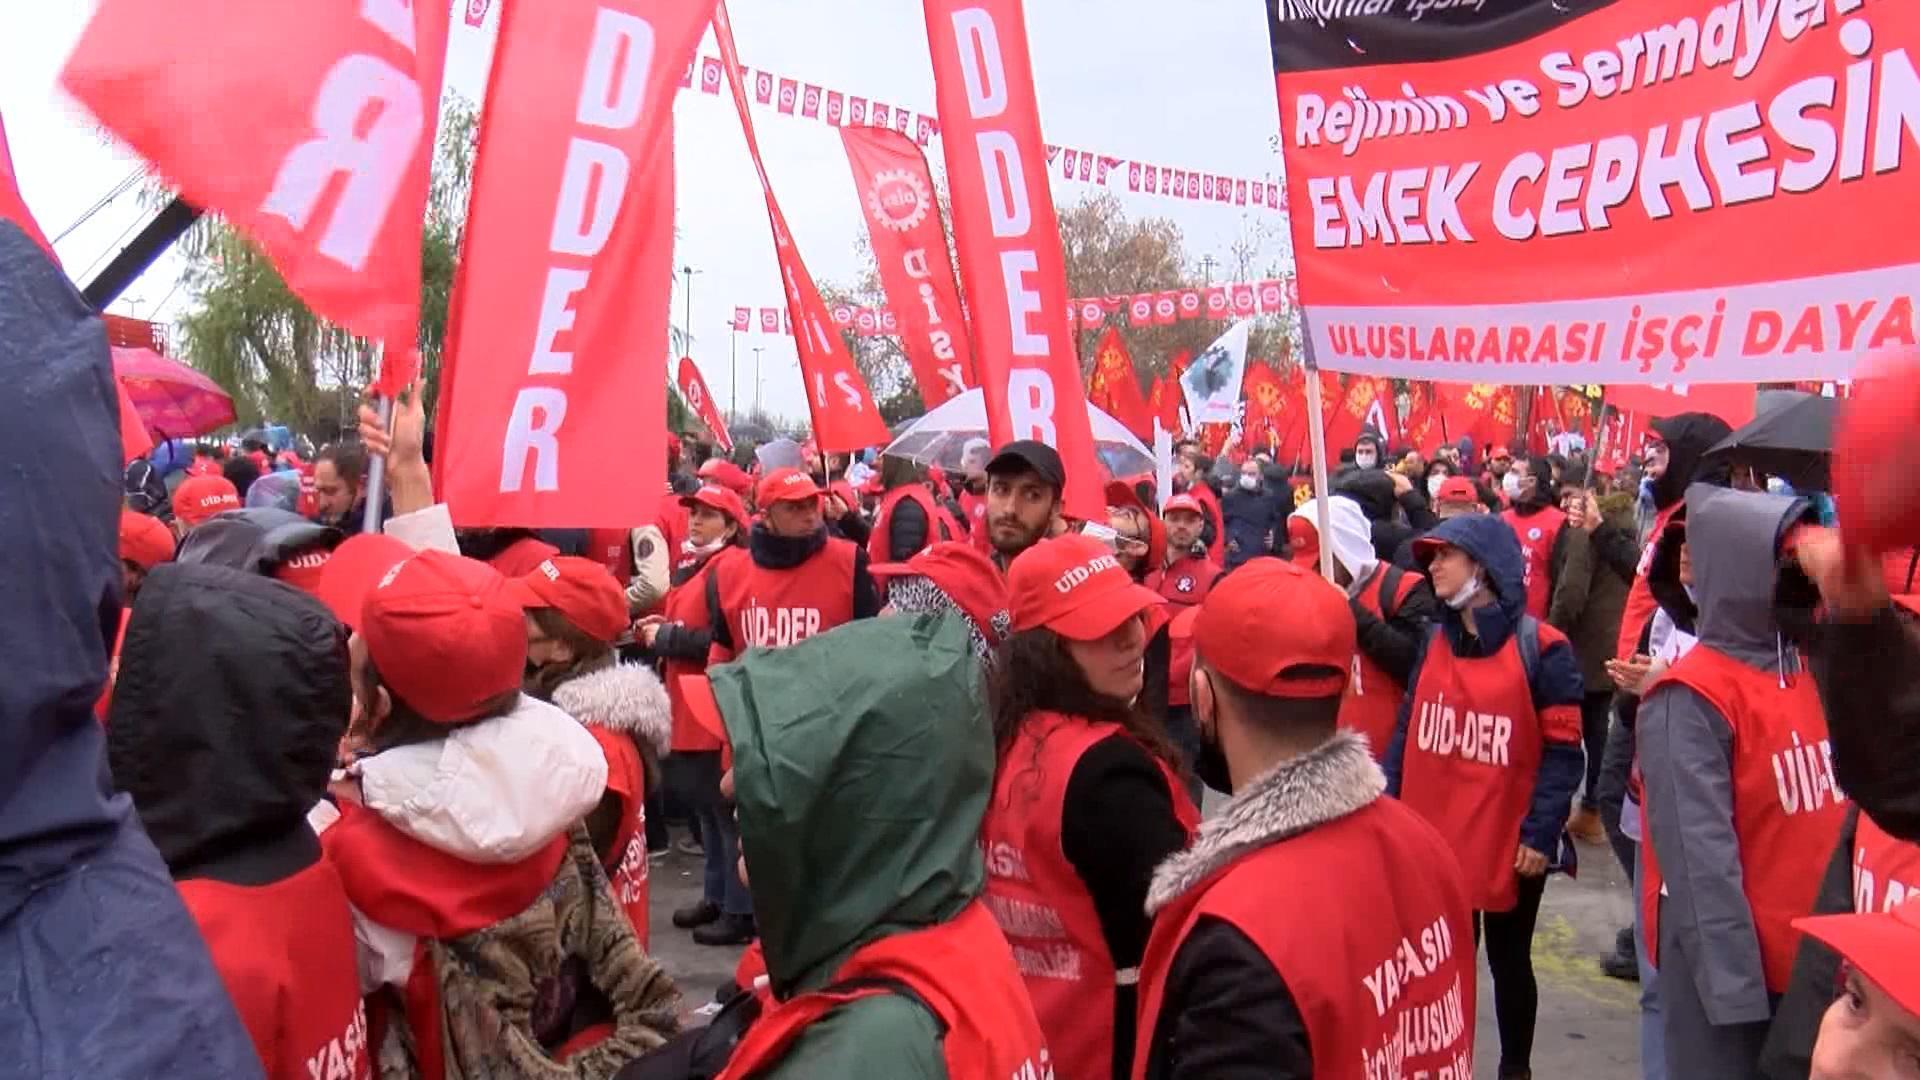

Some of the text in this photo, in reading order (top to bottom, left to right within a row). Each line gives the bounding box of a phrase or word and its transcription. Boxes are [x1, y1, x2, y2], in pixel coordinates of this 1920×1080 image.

[1296, 81, 1469, 156] Rejimin
[1464, 79, 1541, 122] ve
[1307, 161, 1480, 249] EMEK
[1327, 296, 1917, 374] ULUSLARARASI İŞÇİ DAYA
[1417, 691, 1513, 767] UİD-DER
